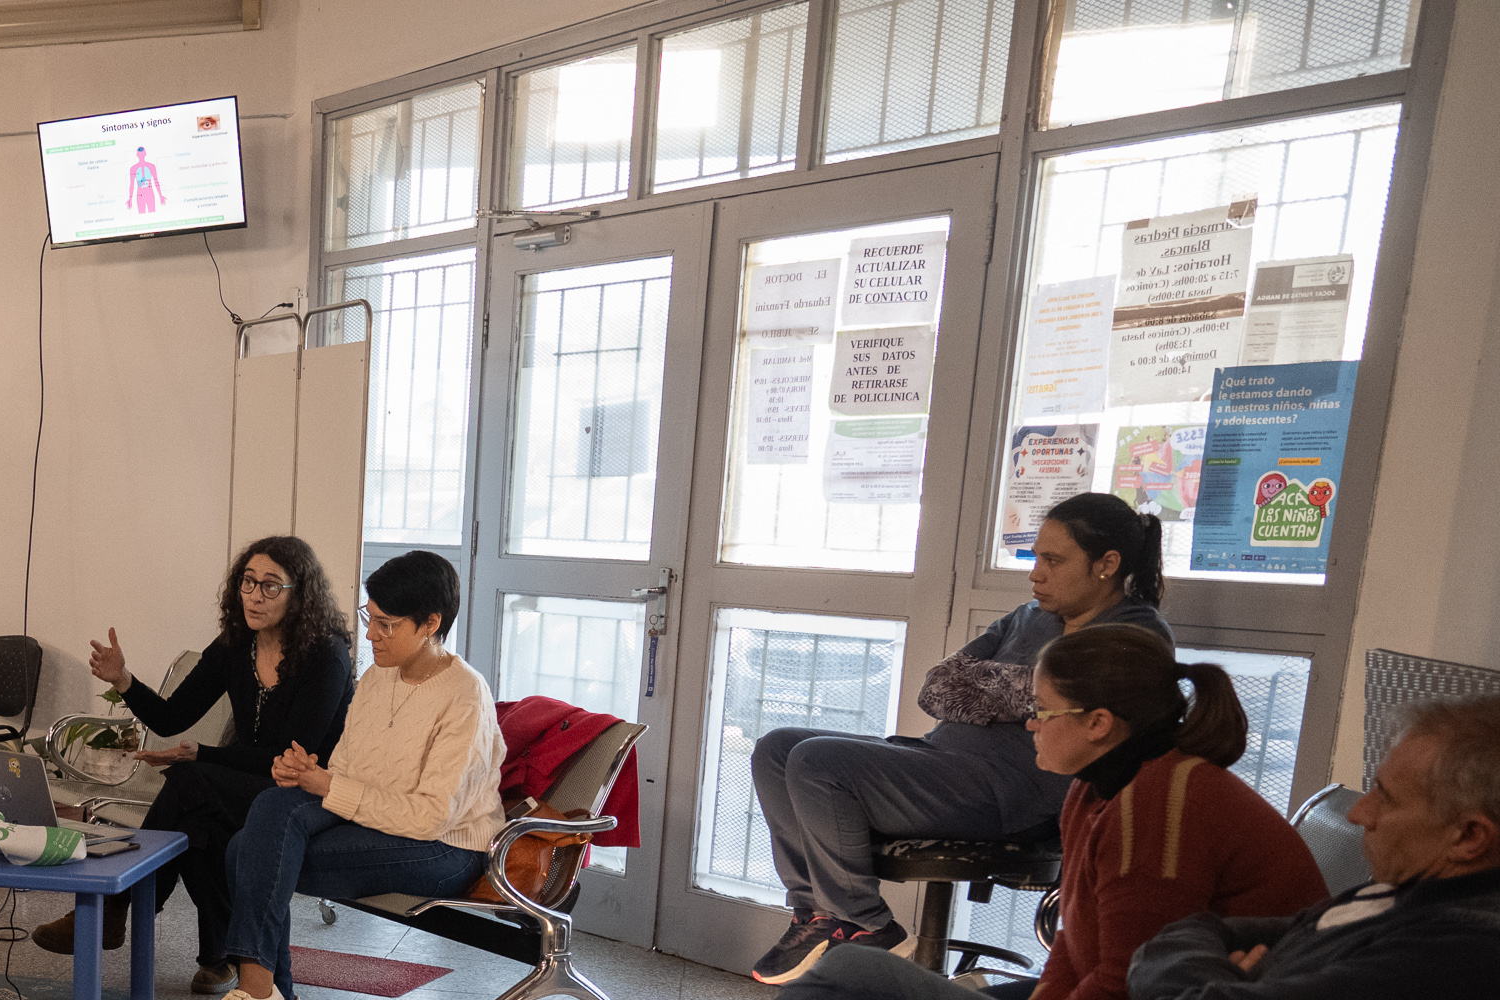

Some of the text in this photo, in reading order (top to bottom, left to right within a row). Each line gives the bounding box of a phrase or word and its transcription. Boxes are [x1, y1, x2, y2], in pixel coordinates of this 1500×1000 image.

[147, 116, 172, 127] signos
[864, 244, 924, 258] RECUERDE
[855, 259, 926, 274] ACTUALIZAR
[854, 274, 922, 288] SU CELULAR
[848, 290, 928, 304] DE CONTACTO
[851, 337, 904, 349] VERIFIQUE
[853, 350, 915, 362] SUS DATOS
[846, 364, 901, 376] ANTES DE
[851, 378, 908, 389] RETIRARSE
[1220, 376, 1275, 389] ¿Qué trato
[834, 391, 919, 404] DE POLICLINICA
[1218, 387, 1312, 400] le estamos dando
[1225, 402, 1270, 413] nuestros
[1272, 401, 1306, 411] niños,
[1309, 399, 1340, 409] niñas
[1215, 414, 1298, 428] y adolescentes?
[1028, 437, 1079, 446] EXPERIENCIAS
[1031, 448, 1073, 456] OPORTUNAS
[1271, 489, 1309, 505] ACÁ
[1258, 525, 1316, 537] CUENTAN
